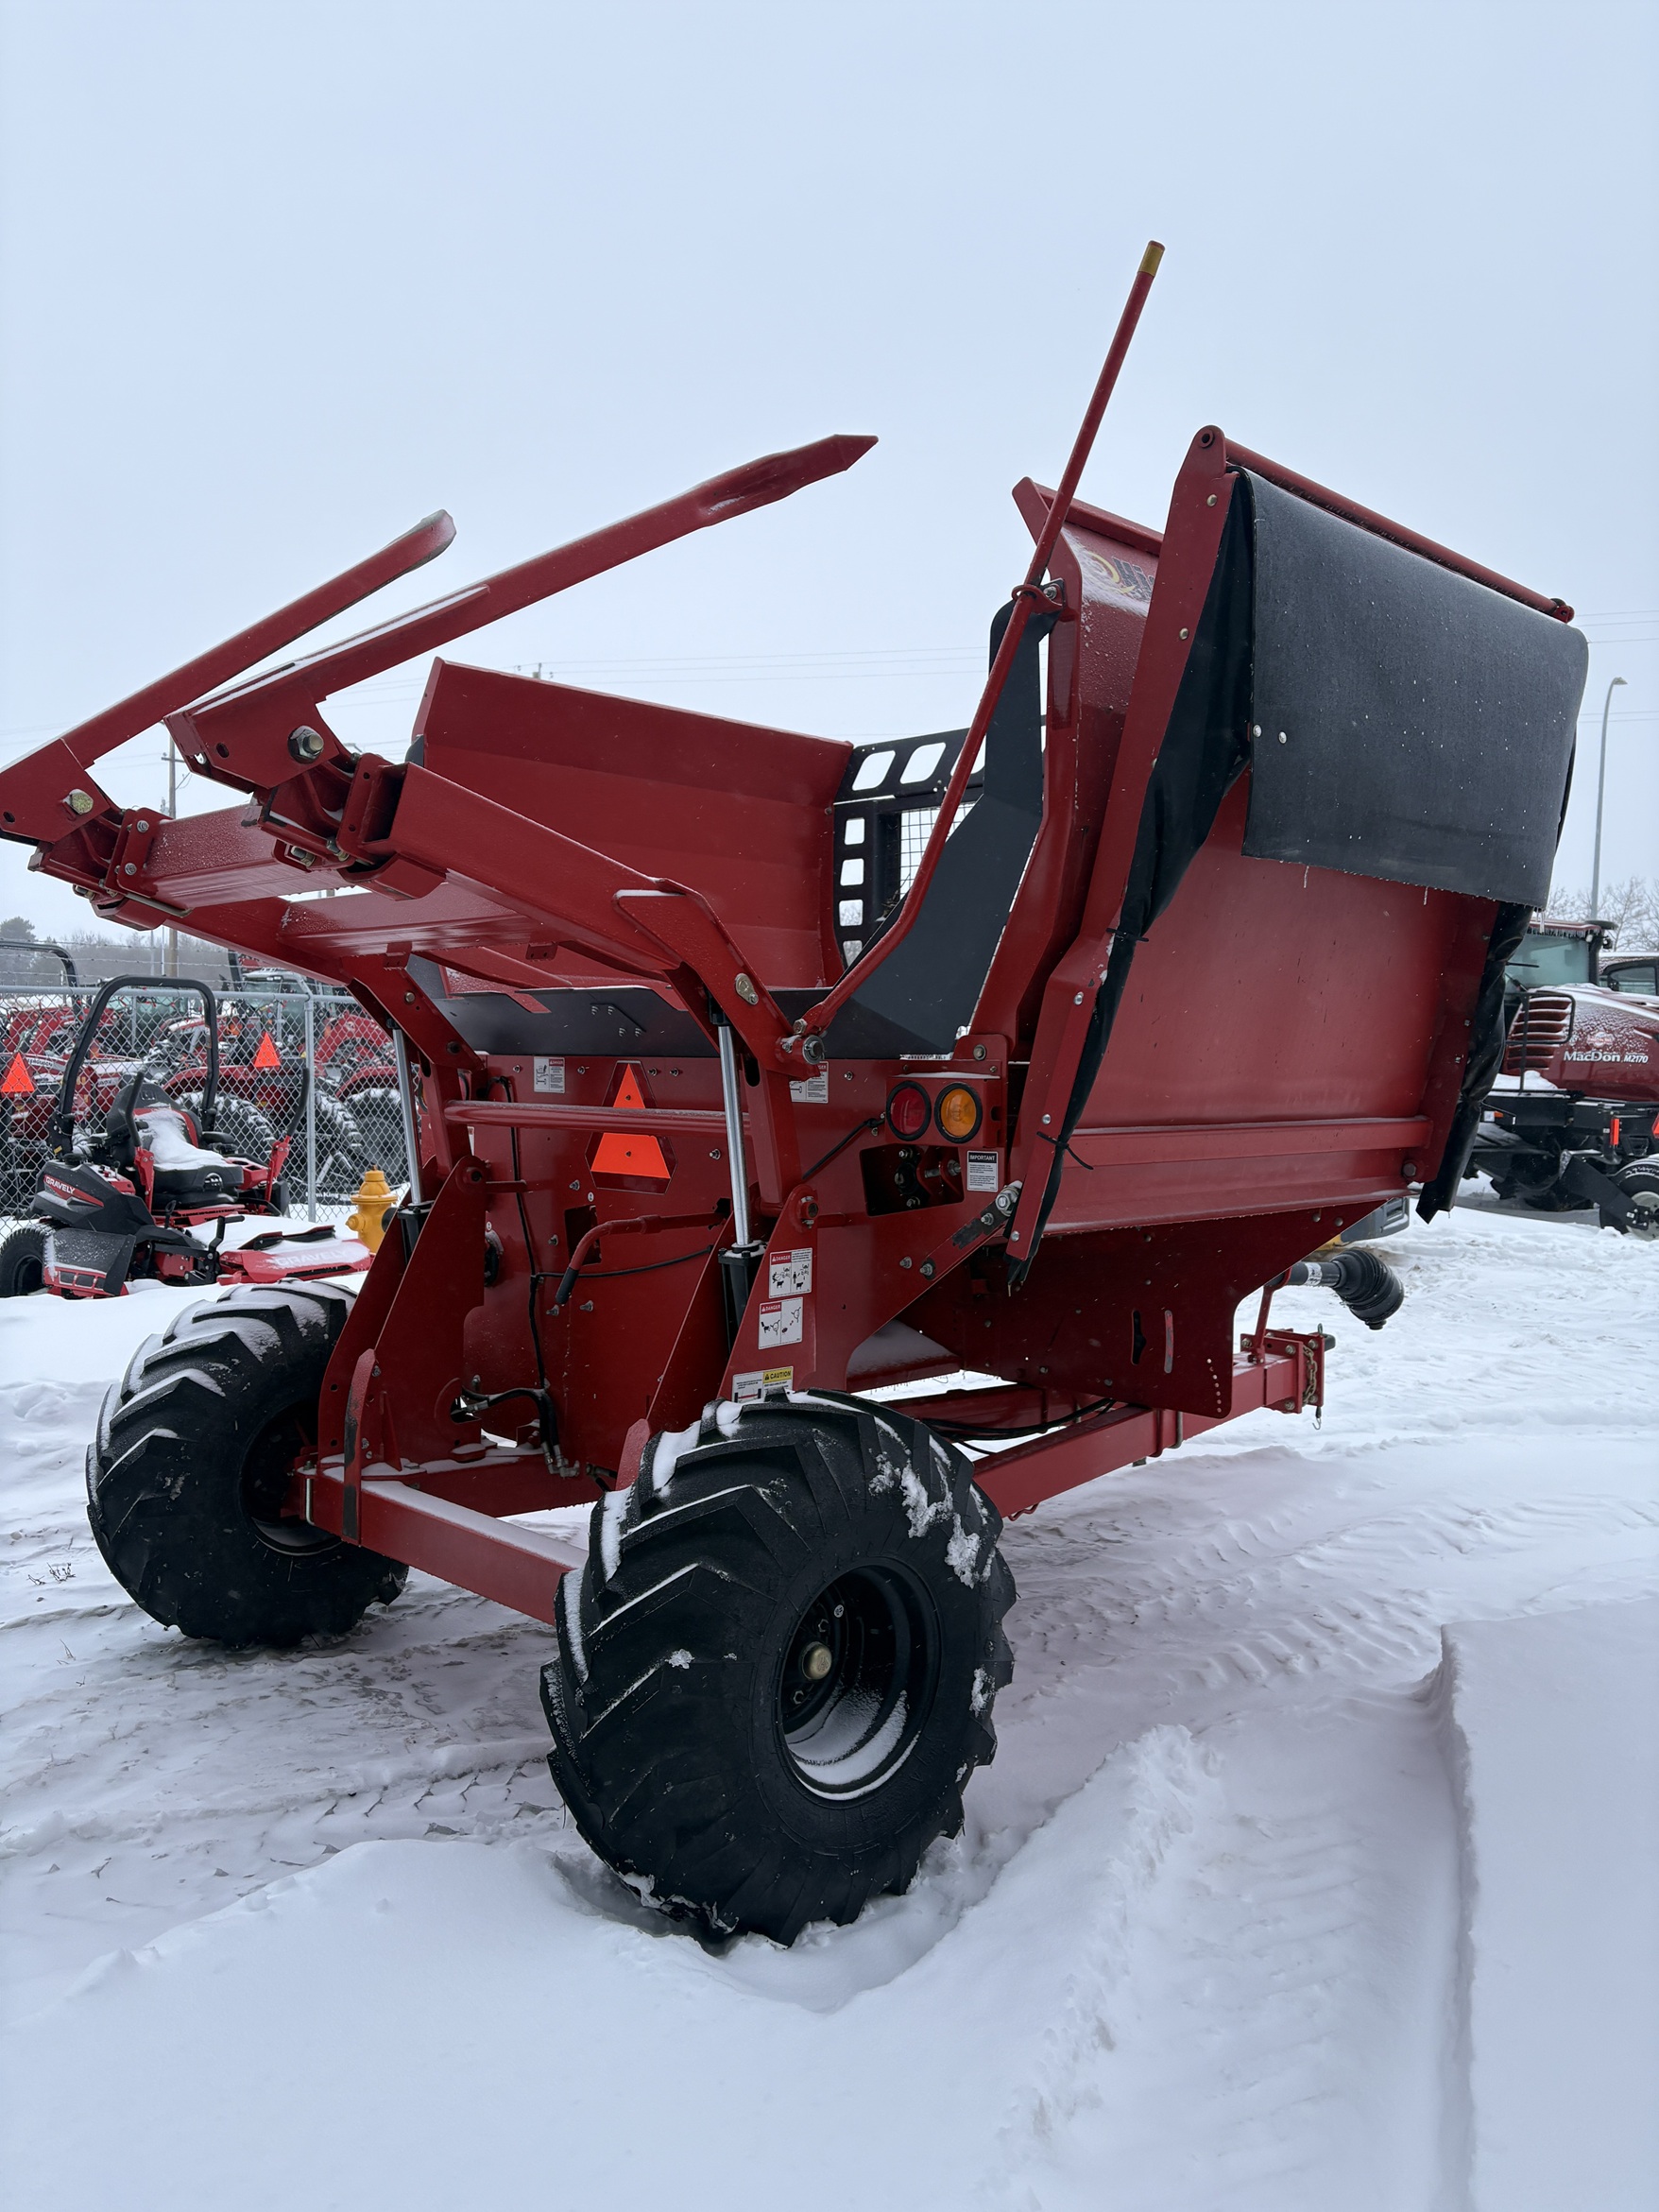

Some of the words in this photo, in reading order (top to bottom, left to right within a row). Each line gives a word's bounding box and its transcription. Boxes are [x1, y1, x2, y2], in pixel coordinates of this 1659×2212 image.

[1564, 1051, 1621, 1062] MacDon
[1623, 1055, 1649, 1063] M2170
[45, 1176, 75, 1194] GRAVELY
[275, 1249, 347, 1266] GRAVELY
[770, 1370, 792, 1380] CAUTION
